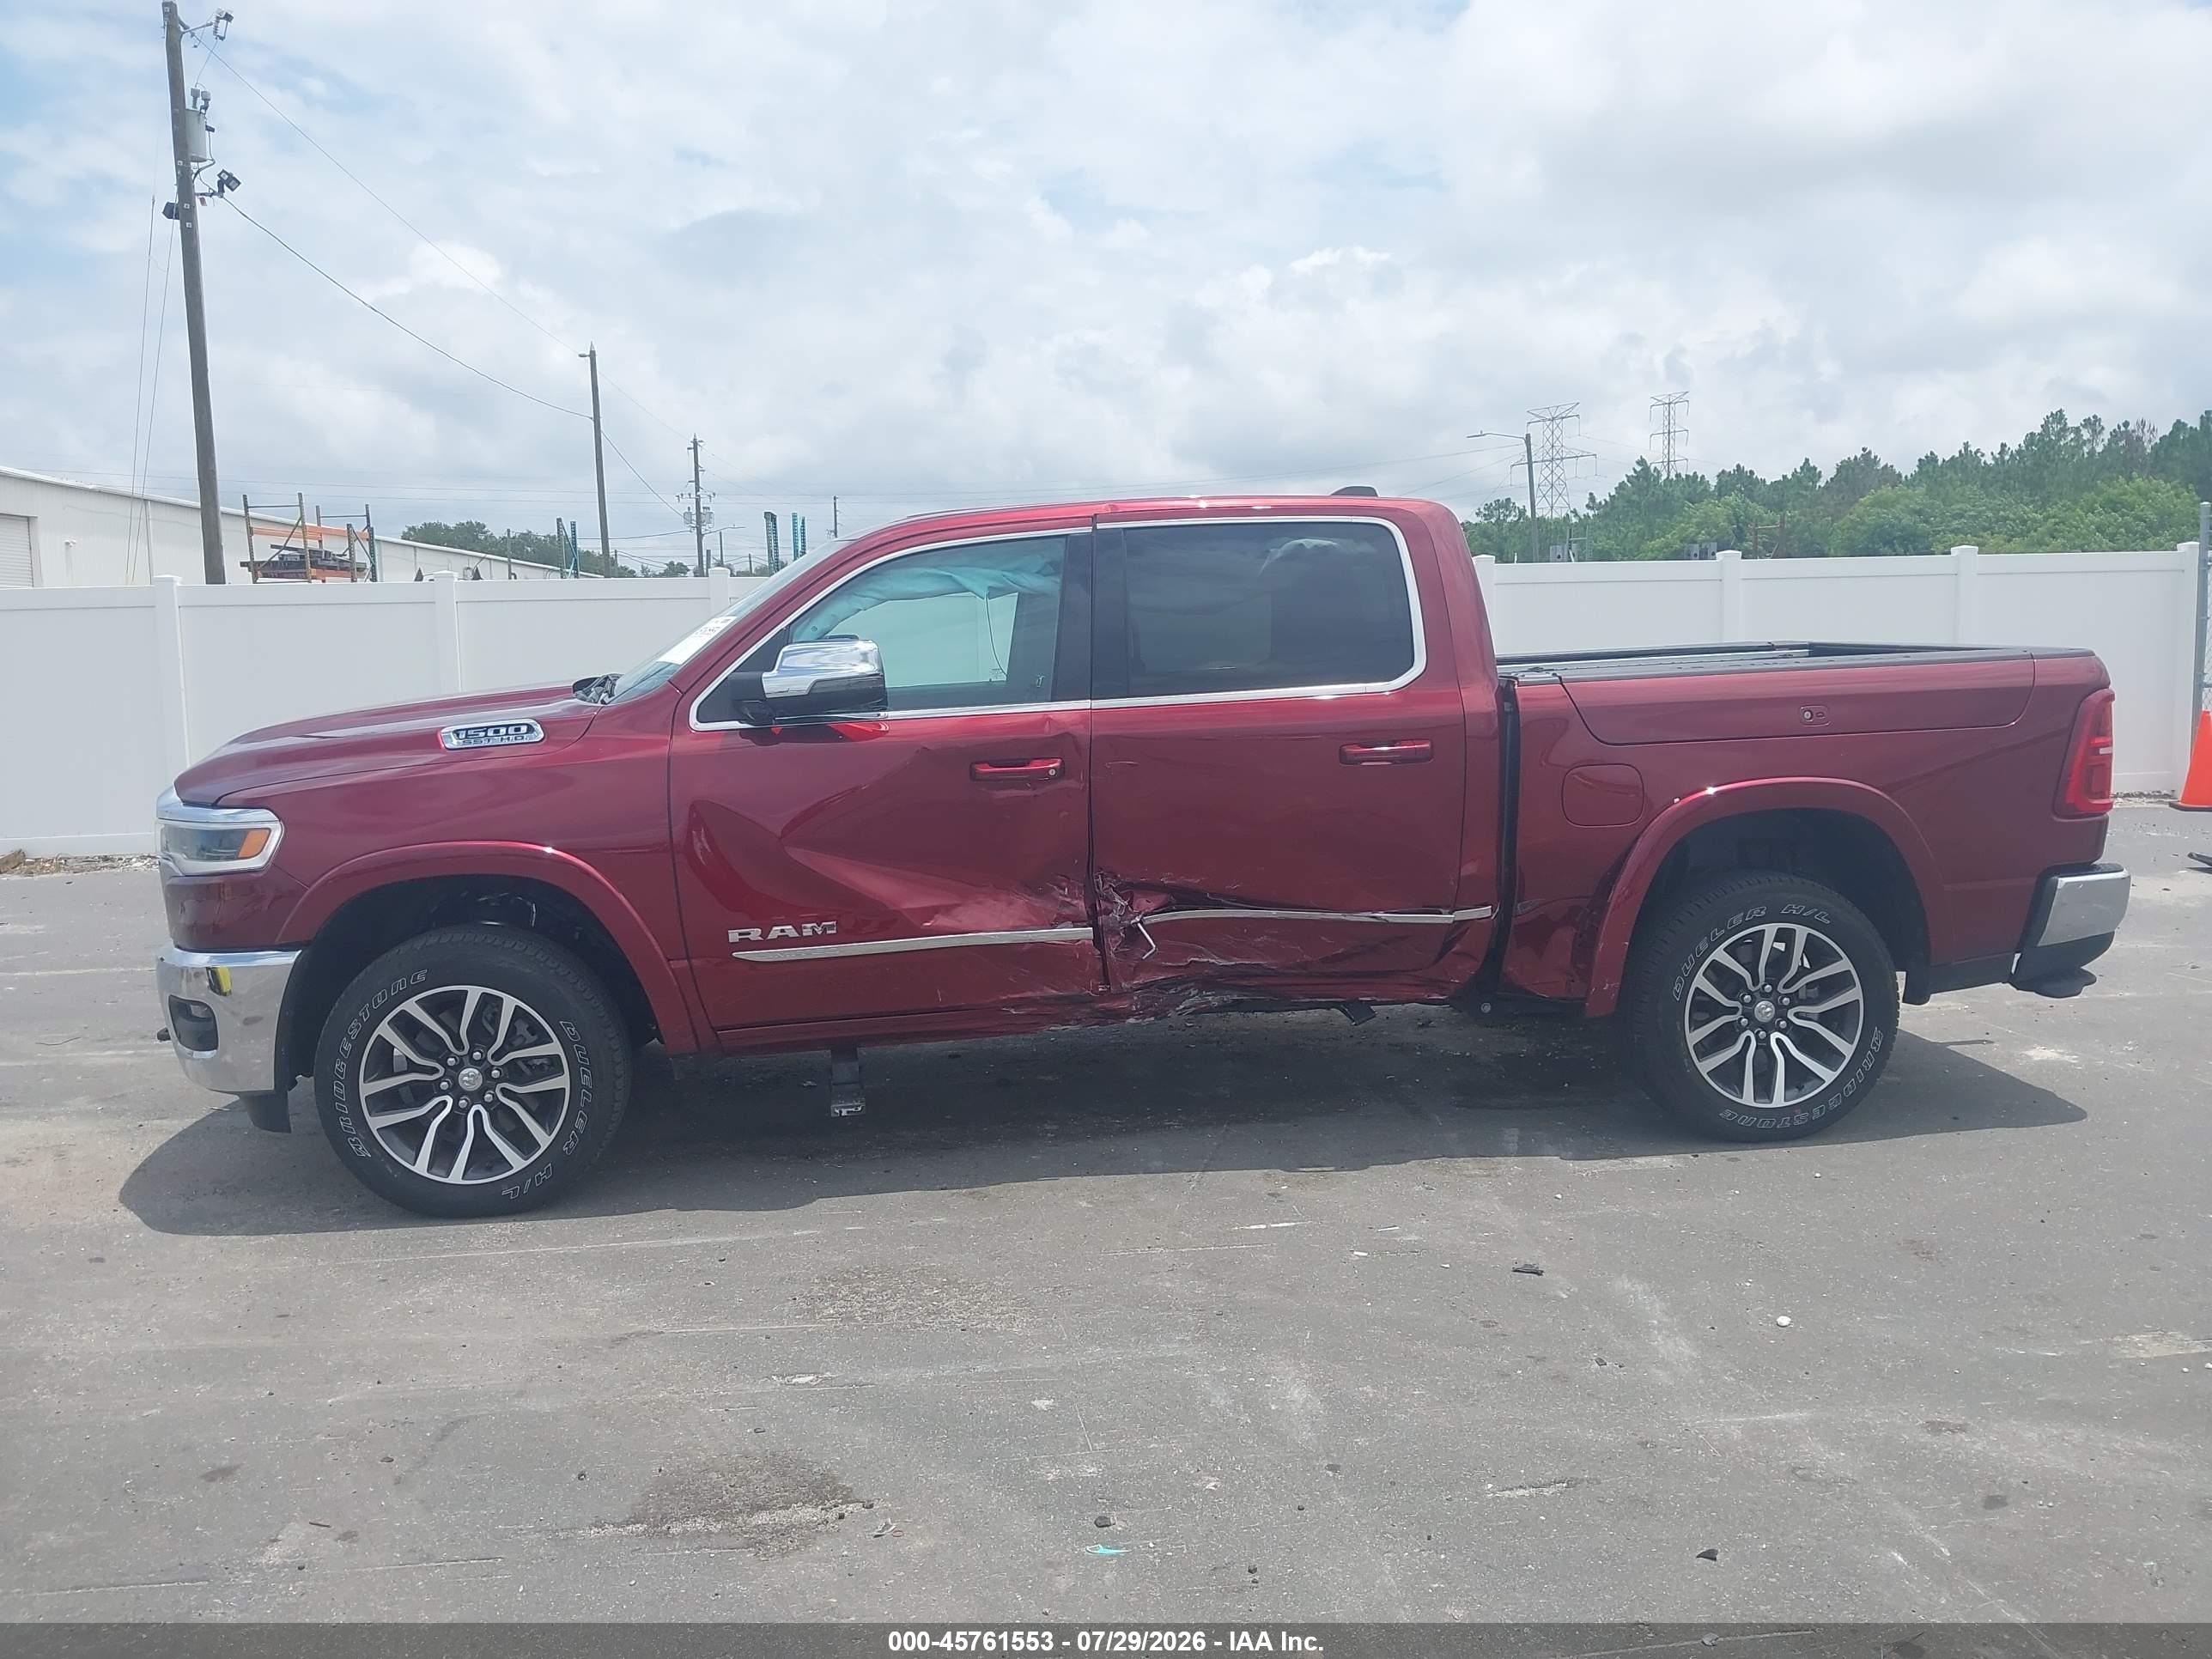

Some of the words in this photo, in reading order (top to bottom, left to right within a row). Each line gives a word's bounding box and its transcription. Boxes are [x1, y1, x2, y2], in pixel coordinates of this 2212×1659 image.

[457, 725, 529, 740] 1500
[727, 921, 838, 943] RAM
[1672, 906, 1767, 1001] DUELER
[1779, 903, 1831, 925] H/L
[333, 968, 428, 1158] BRIDGESTONE
[560, 1019, 592, 1155] DUELER
[1719, 1026, 1884, 1128] BRIDGESTONE
[501, 1163, 554, 1200] H/L
